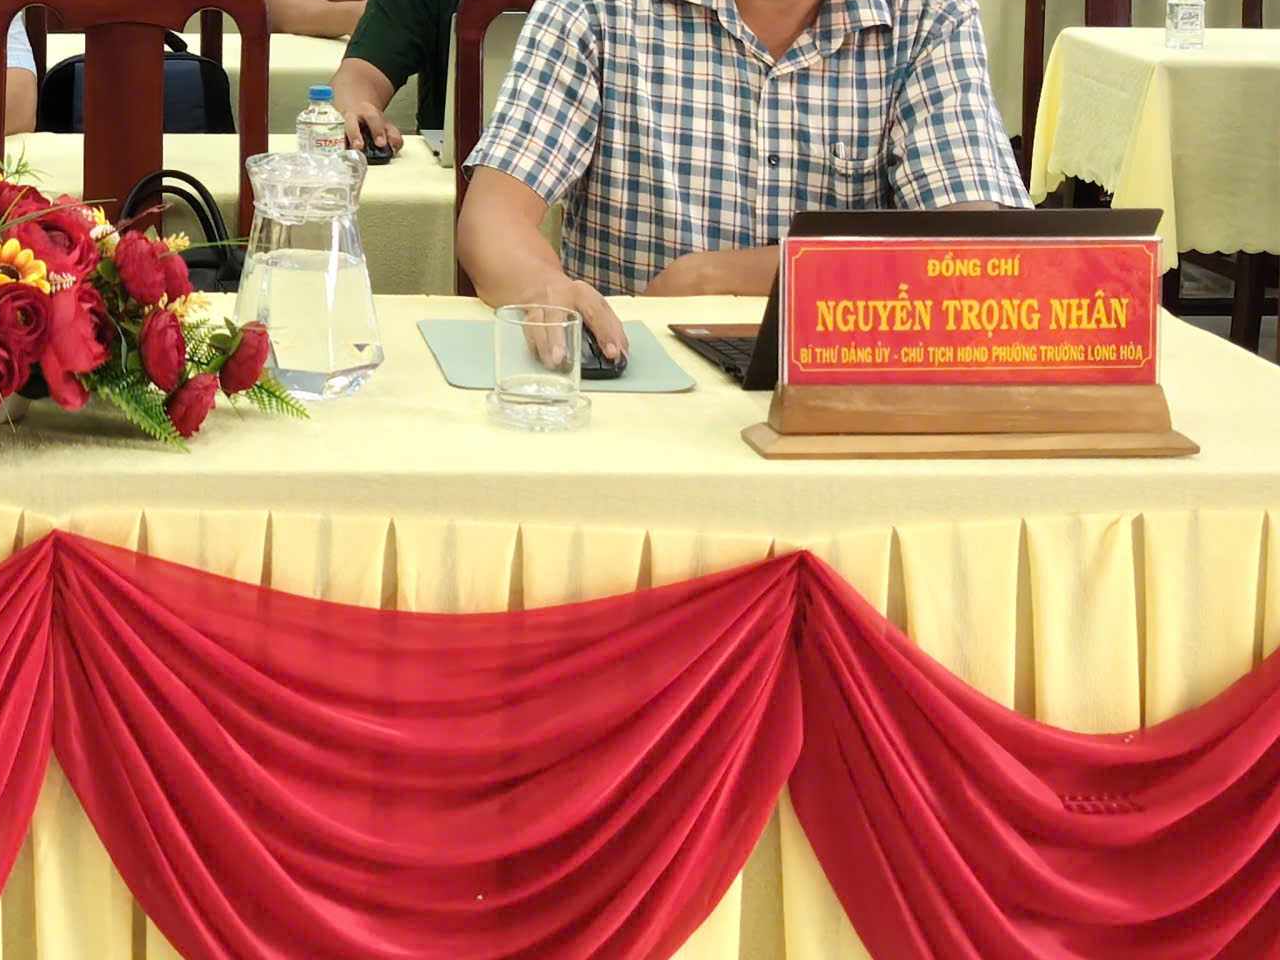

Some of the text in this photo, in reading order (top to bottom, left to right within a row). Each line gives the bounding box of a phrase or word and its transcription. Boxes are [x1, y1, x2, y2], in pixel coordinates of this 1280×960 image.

[927, 251, 1020, 277] ĐỒNG CHÍ
[816, 283, 1129, 338] NGUYỄN TRỌNG NHÂN
[799, 344, 813, 363] BÍ
[814, 344, 840, 364] THƯ
[875, 340, 890, 363] ỦY
[901, 341, 925, 363] CHỦ
[927, 346, 954, 367] TỊCH
[992, 342, 1038, 362] PHƯỜNG
[1039, 341, 1085, 361] TRƯỜNG
[1088, 344, 1117, 361] LONG
[1120, 340, 1143, 361] HÒA
